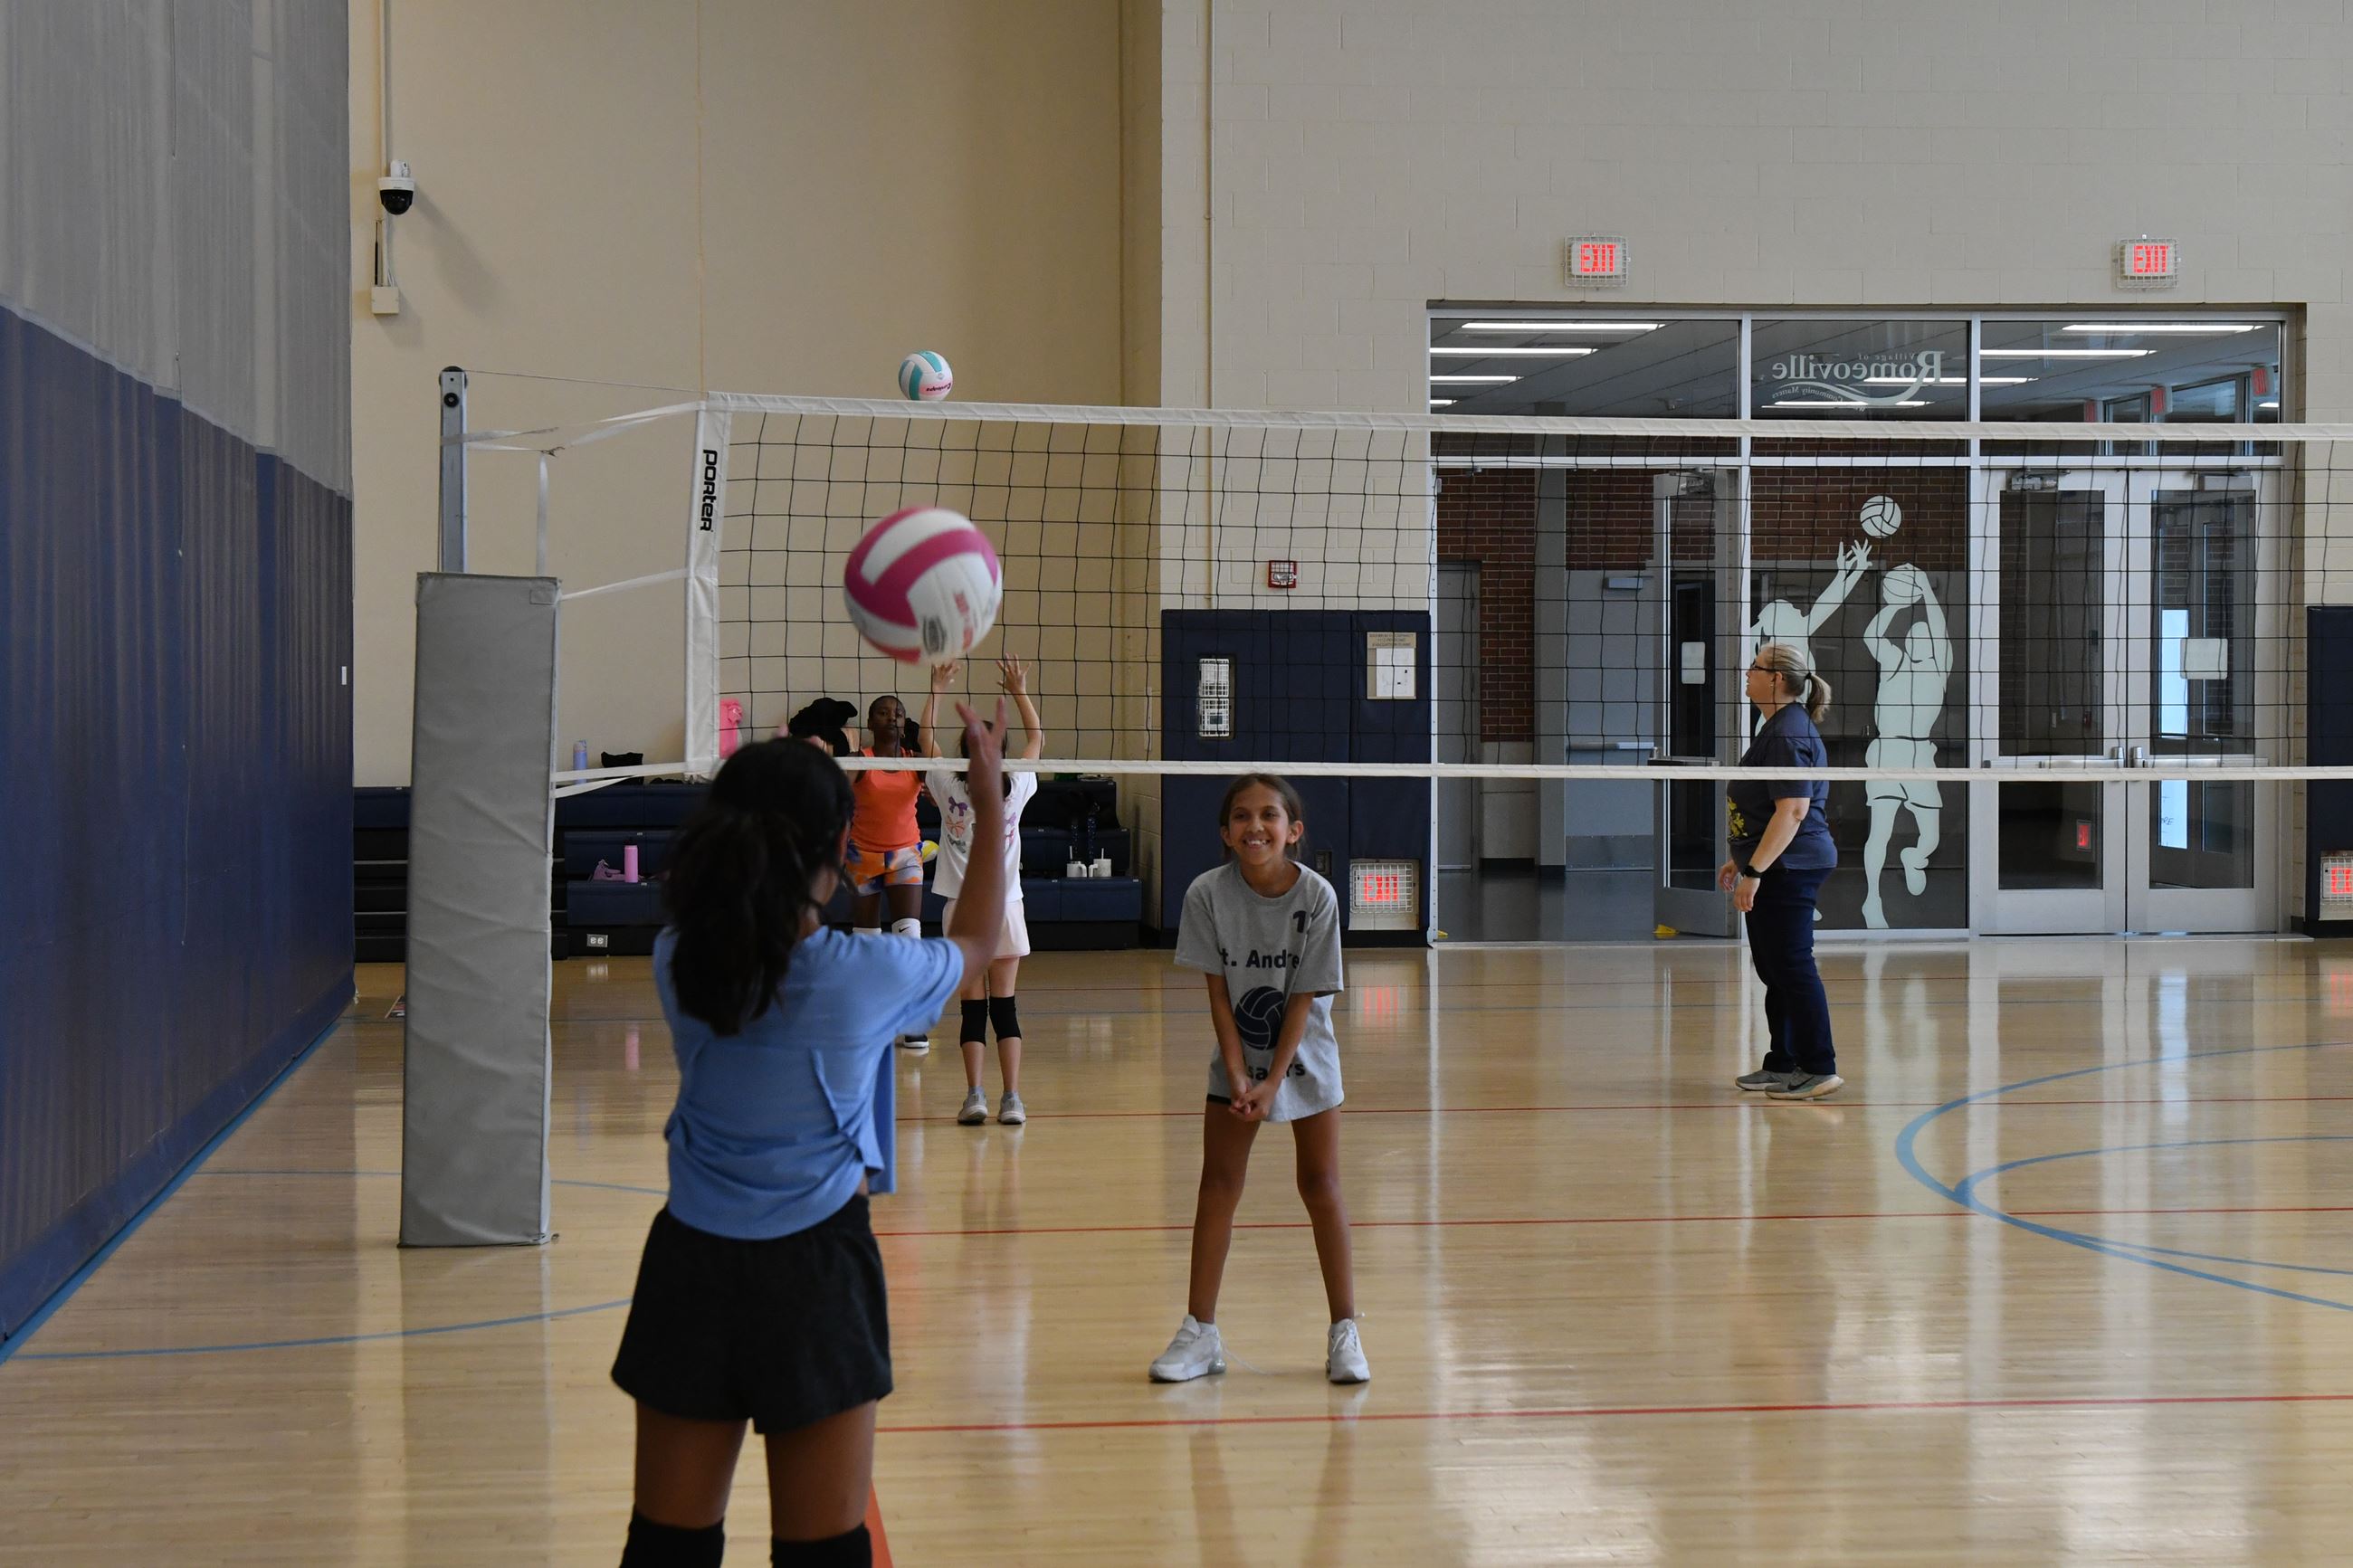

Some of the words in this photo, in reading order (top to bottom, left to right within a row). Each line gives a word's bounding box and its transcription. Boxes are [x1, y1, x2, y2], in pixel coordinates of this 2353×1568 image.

[1579, 243, 1616, 273] EXIT
[2133, 245, 2169, 273] EXIT
[1364, 874, 1398, 902] EXIT
[1218, 947, 1237, 967] t.
